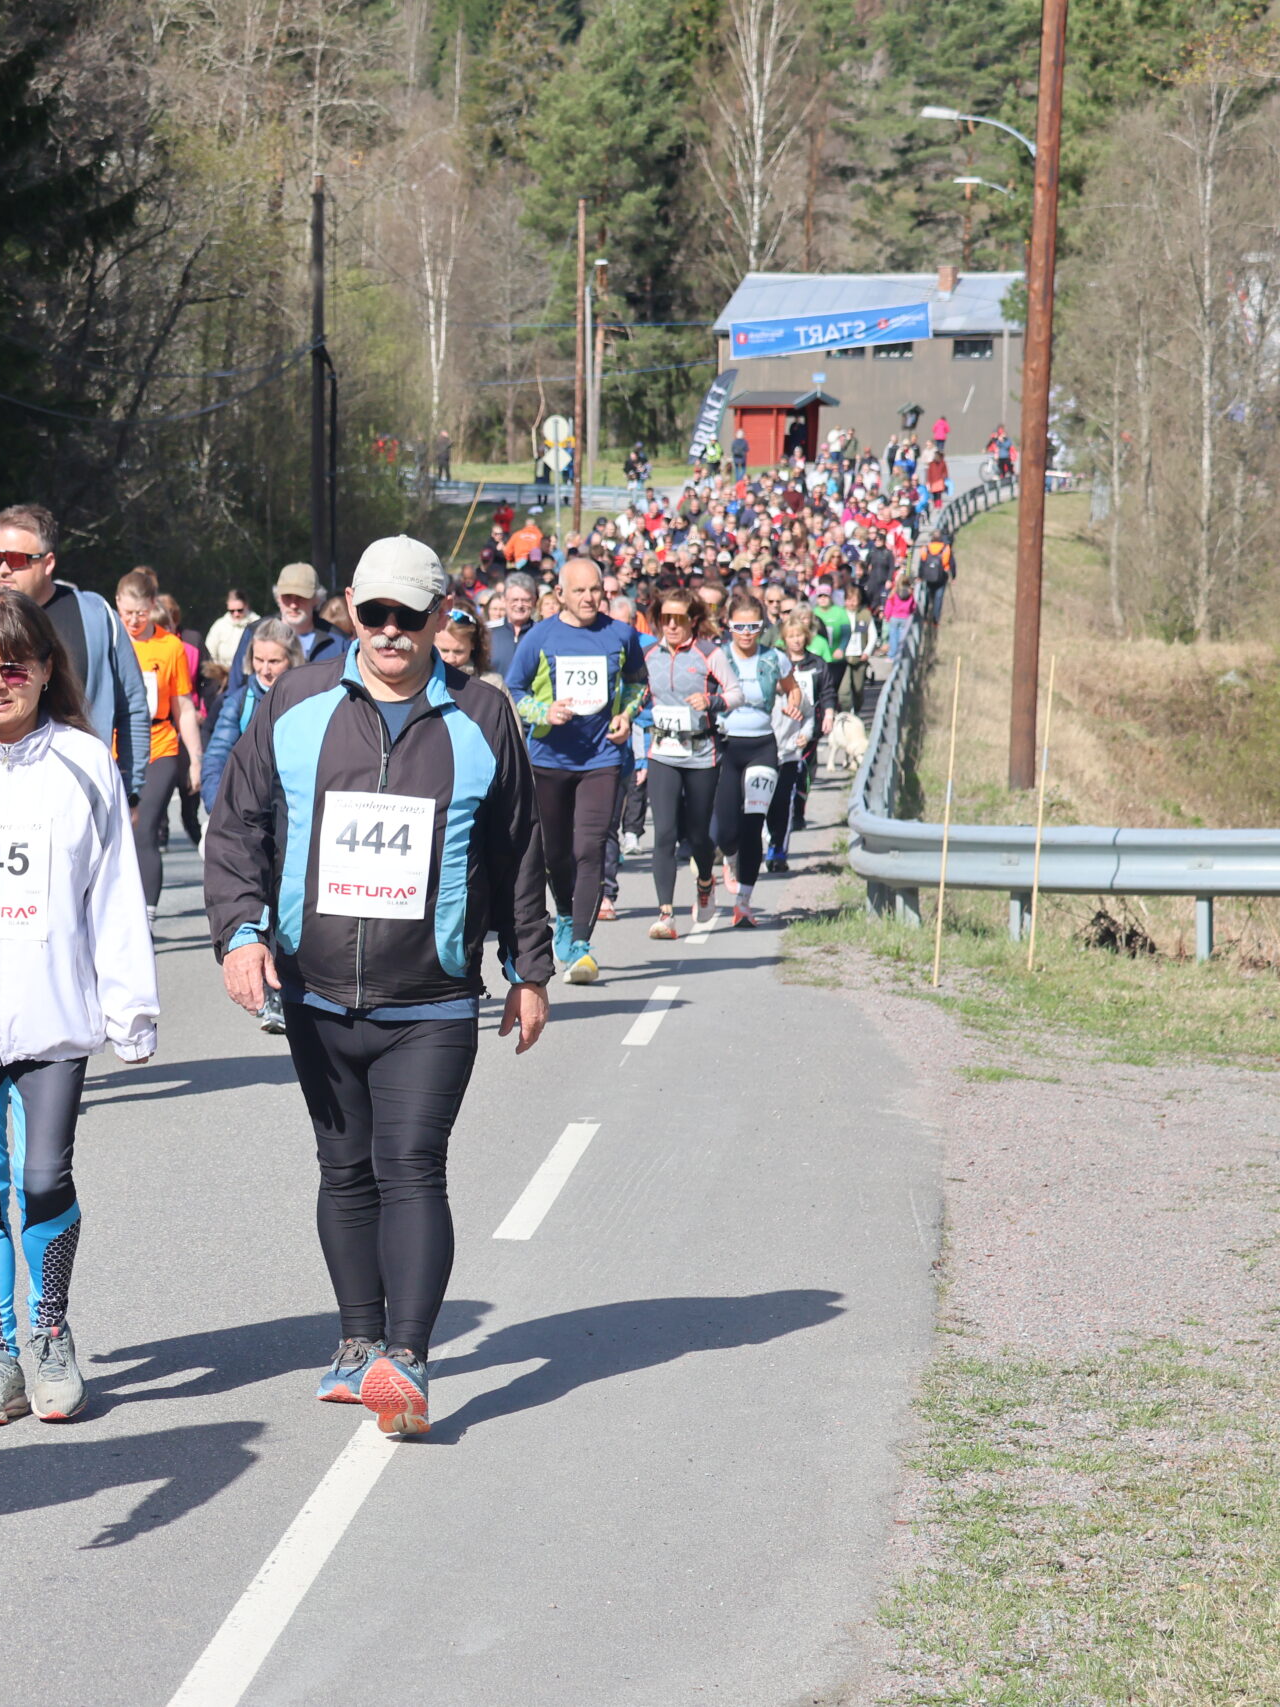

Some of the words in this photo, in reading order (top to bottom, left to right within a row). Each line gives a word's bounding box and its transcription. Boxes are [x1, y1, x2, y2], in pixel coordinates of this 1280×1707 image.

[564, 670, 598, 686] 739
[659, 717, 681, 731] 471
[751, 776, 775, 794] 470
[335, 819, 412, 856] 444
[328, 882, 409, 899] RETURA
